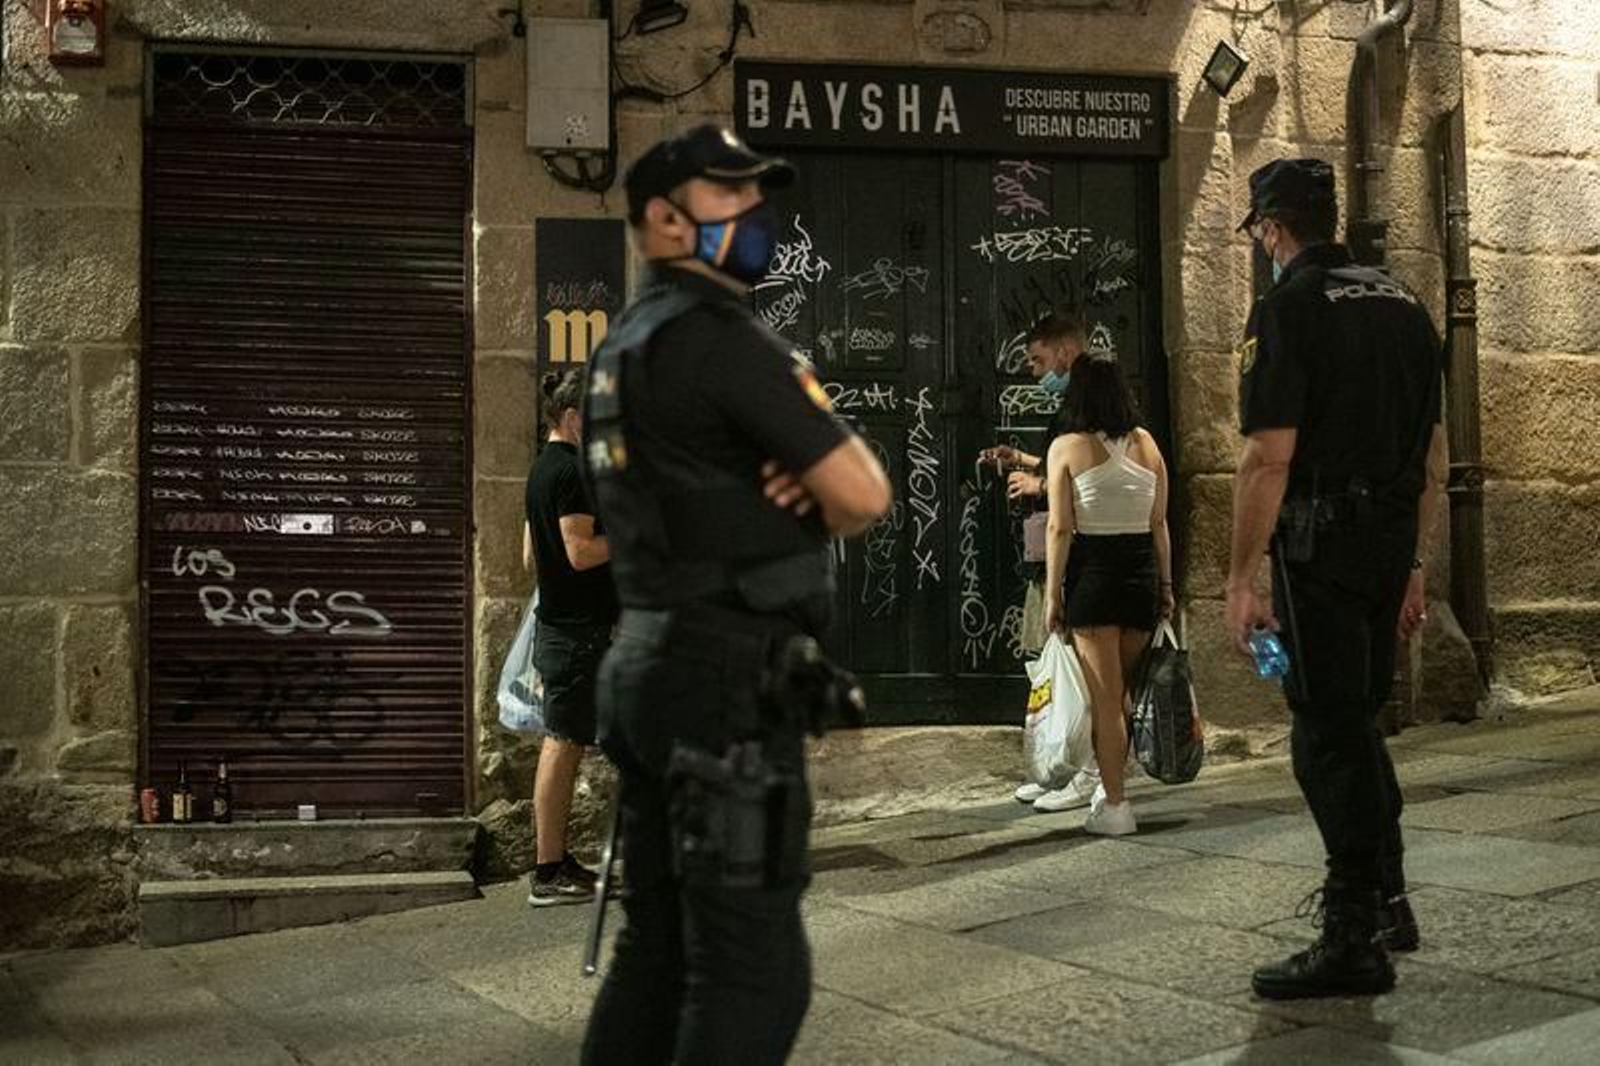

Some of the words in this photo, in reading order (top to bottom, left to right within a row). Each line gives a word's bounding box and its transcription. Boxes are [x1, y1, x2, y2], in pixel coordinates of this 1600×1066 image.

[746, 78, 961, 134] BAYSHA
[1005, 87, 1082, 110] DESCUBRE
[1084, 90, 1151, 113] NUESTRO
[1016, 114, 1072, 137] URBAN
[1075, 116, 1141, 139] GARDEN
